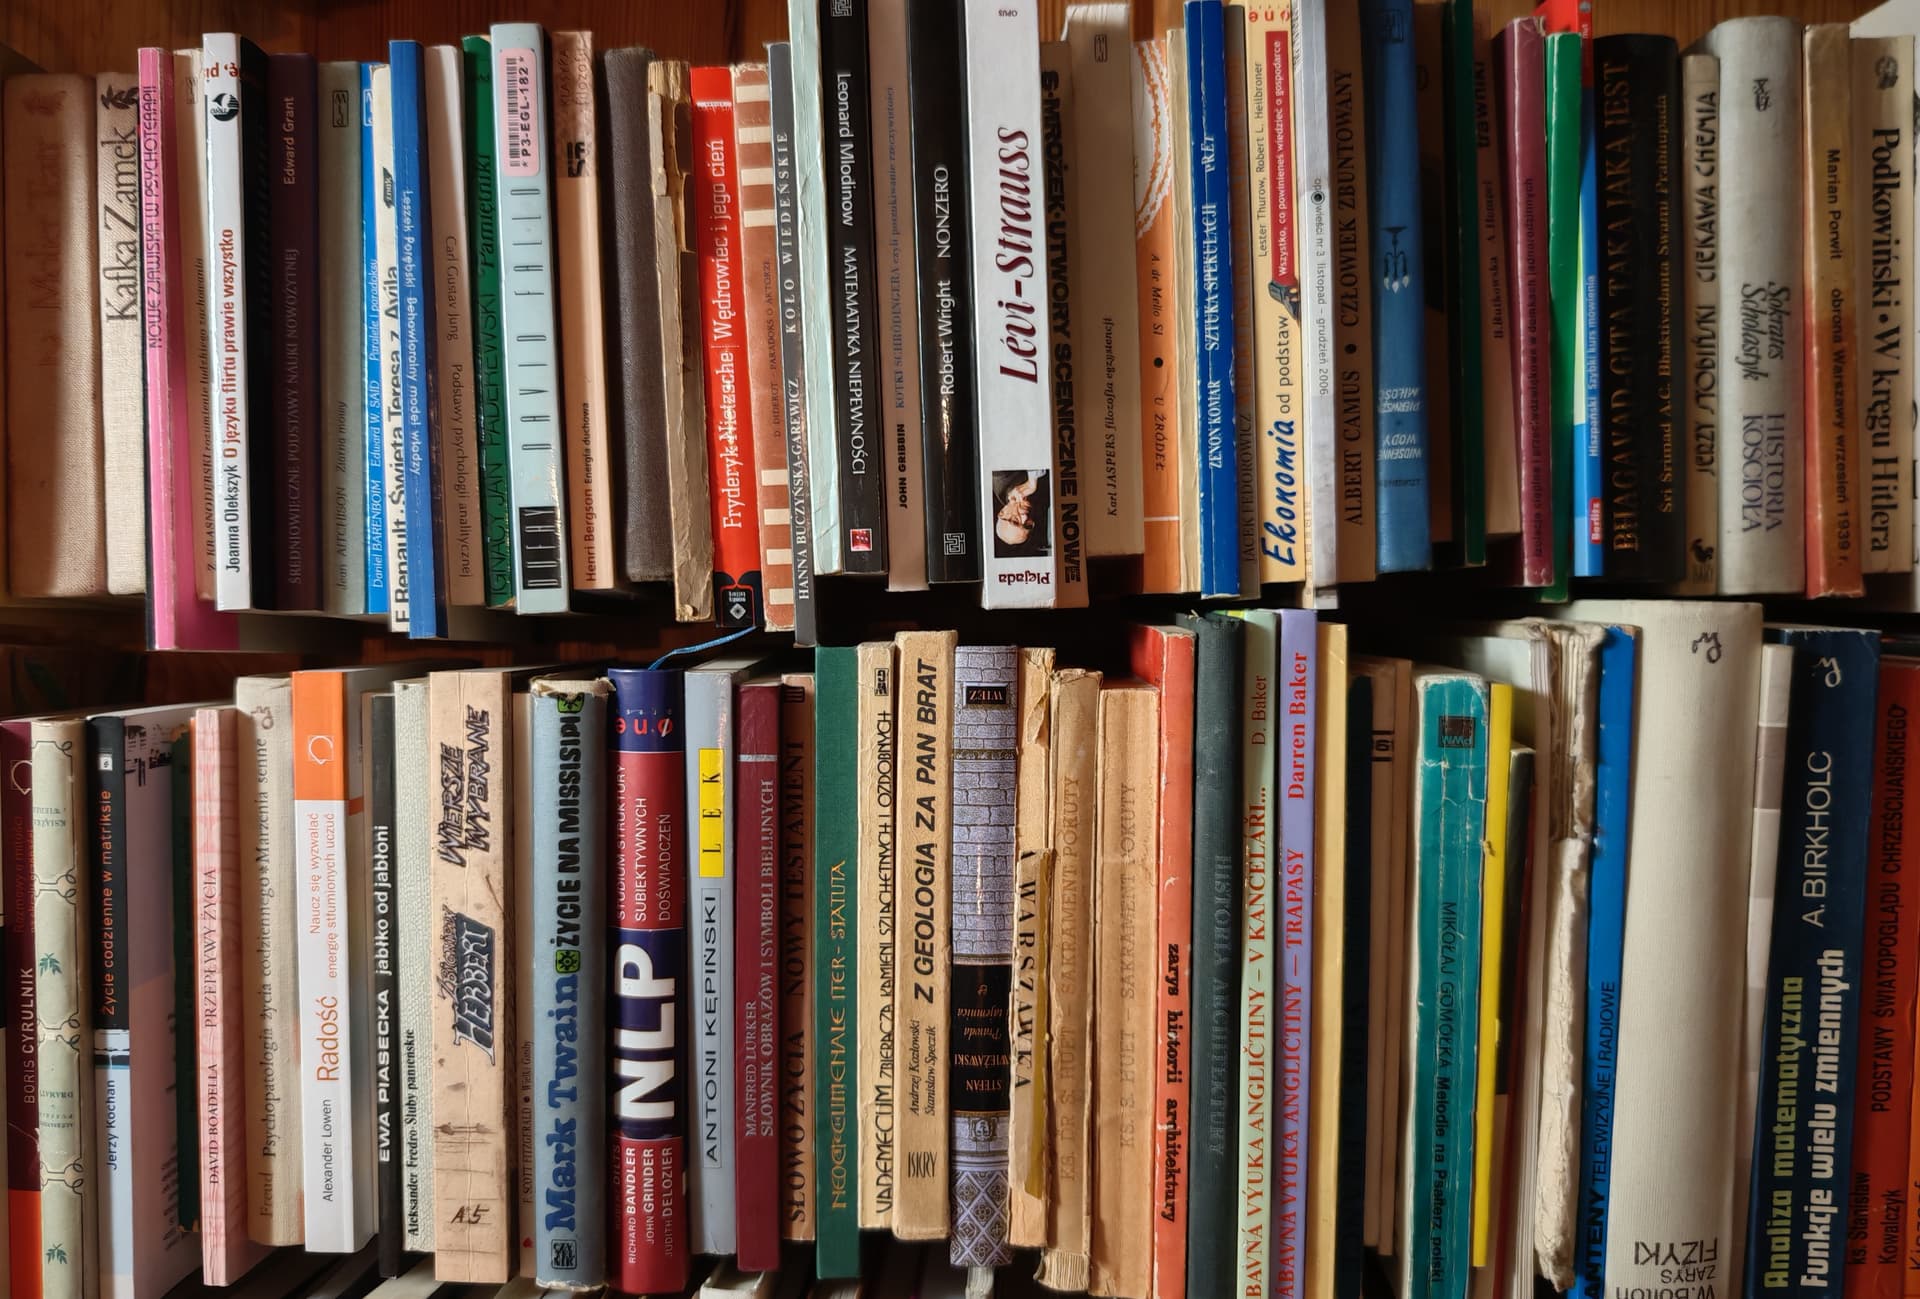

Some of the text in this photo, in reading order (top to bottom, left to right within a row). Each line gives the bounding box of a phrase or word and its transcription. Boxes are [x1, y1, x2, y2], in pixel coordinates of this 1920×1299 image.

[998, 8, 1018, 17] OPUS
[282, 96, 295, 184] Edward Grant
[517, 66, 532, 157] P3-EGL-182
[706, 138, 727, 177] cień
[1253, 61, 1269, 258] Lester Thurow, Robert L. Heilbroner
[1273, 40, 1289, 277] Wszystko, powinieneś wiedzieć gospodarce
[101, 126, 138, 322] Kafka Zamek
[143, 203, 159, 218] W
[384, 178, 394, 201] znak
[710, 182, 731, 221] jego
[995, 126, 1039, 384] Lévi-Strauss
[709, 237, 737, 340] Wędrowiec
[837, 71, 869, 475] Leonard Mlodinow MATEMATYKA NIEPEWNOŚCI
[934, 165, 955, 395] Robert Wright NONZERO
[1201, 202, 1222, 469] ZENON KOMAR SZTUKA SPEKULACJI
[1334, 68, 1365, 527] ALBERT CAMUS CZŁOWIEK ZBUNTOWANY
[1865, 127, 1902, 552] Podkowiński W kręgu Hitlera
[216, 228, 241, 574] Joanna Olekszyk O języku flirtu prawie wszystko
[446, 235, 473, 578] Carl Gustav Jung Podstawy psychologii analitycznej
[715, 352, 738, 441] Nietzsche
[775, 131, 810, 600] HANNA BUCZYŃSKA-GAREWICZ KOŁO WIEDEŃSKIE
[1102, 317, 1117, 517] Karl JASPERS filozofia egzystencji
[580, 402, 597, 582] Henri Bergson Energia duchowa
[722, 446, 747, 529] Fryderyk
[896, 423, 908, 509] JOHN GRIBBIN
[1055, 343, 1082, 584] SCENICZNE NOWE
[1261, 315, 1297, 566] Ekonomia od podstaw
[1766, 413, 1786, 530] HISTORIA
[998, 571, 1050, 586] Plejada
[464, 704, 491, 854] WYBRANE
[1251, 674, 1267, 745] D. Baker
[1287, 651, 1308, 800] Darren Baker
[307, 812, 322, 934] Naucz się wyzwalać
[323, 812, 339, 979] energię stłumionych uczuć
[634, 797, 648, 922] SUBIEKTYWNYCH
[656, 813, 672, 921] DOŚWIADCZEŃ
[914, 657, 938, 1004] Z GEOLOGIĄ ZA PAN BRAT
[1285, 848, 1304, 949] TRAPASY
[1801, 750, 1832, 928] A. BIRKHOLC
[99, 790, 120, 1171] Jerzy Kochan Życie codzienne w matriksie
[545, 716, 581, 1232] Mark Twain ŻYCIE NA MISSISIPI
[1248, 947, 1265, 964] V
[1871, 703, 1906, 1112] PODSTAWY ŚWIATOPOGLĄDU CHRZEŚCIJAŃSKIEGO
[20, 967, 36, 1104] BORIS CYRULNIK
[200, 868, 220, 1185] DAVID BOADELLA PRZEPŁYWY ŻYCIA
[373, 824, 393, 1162] EWA PIASECKA jabłko od jabłoni
[613, 942, 676, 1120] NLP
[702, 896, 719, 1163] ANTONI KĘPIŃSKI
[908, 1019, 922, 1116] Andrzej Kozłowski
[1242, 986, 1266, 1131] ANGLIČTINY
[315, 995, 340, 1202] Alexander Lowen Radość
[745, 1000, 758, 1136] MANFRED LURKER
[925, 1024, 938, 1116] Stanisław Speczik
[1591, 981, 1616, 1185] TELEWIZYJNE RADIOWE
[1763, 976, 1808, 1289] Analiza matematyczna
[1800, 948, 1851, 1287] Funkcje wielu zmiennych
[625, 1146, 637, 1264] RICHARD BANDLER
[643, 1147, 655, 1244] JOHN GRINDER
[661, 1146, 674, 1256] JUDITH DELOZIER
[1242, 1139, 1265, 1217] VÝUKA
[1633, 1236, 1719, 1265] FIZYKI
[1660, 1264, 1717, 1284] ZARYS
